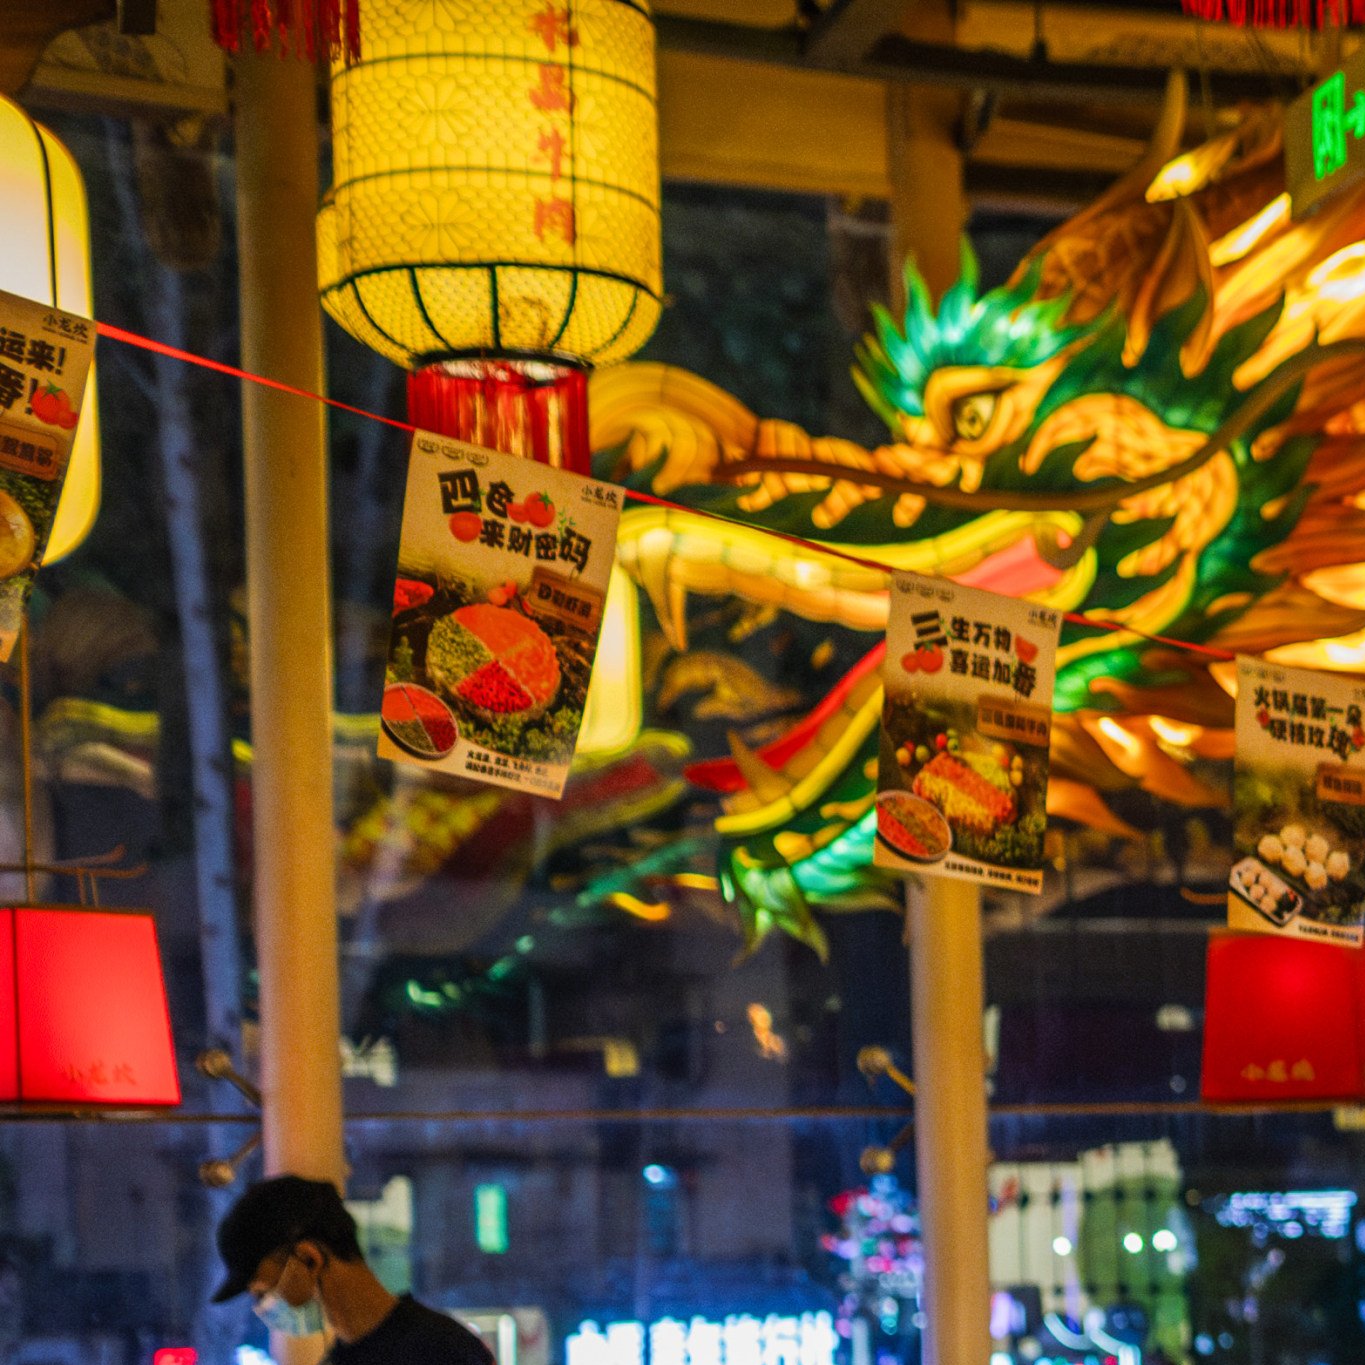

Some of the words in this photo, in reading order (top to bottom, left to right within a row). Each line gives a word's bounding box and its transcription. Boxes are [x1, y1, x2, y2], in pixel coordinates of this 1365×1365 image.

[437, 467, 515, 519] 四色
[479, 517, 592, 573] 来财密码
[910, 609, 1012, 654] 三生万物
[949, 648, 1037, 698] 喜运加番
